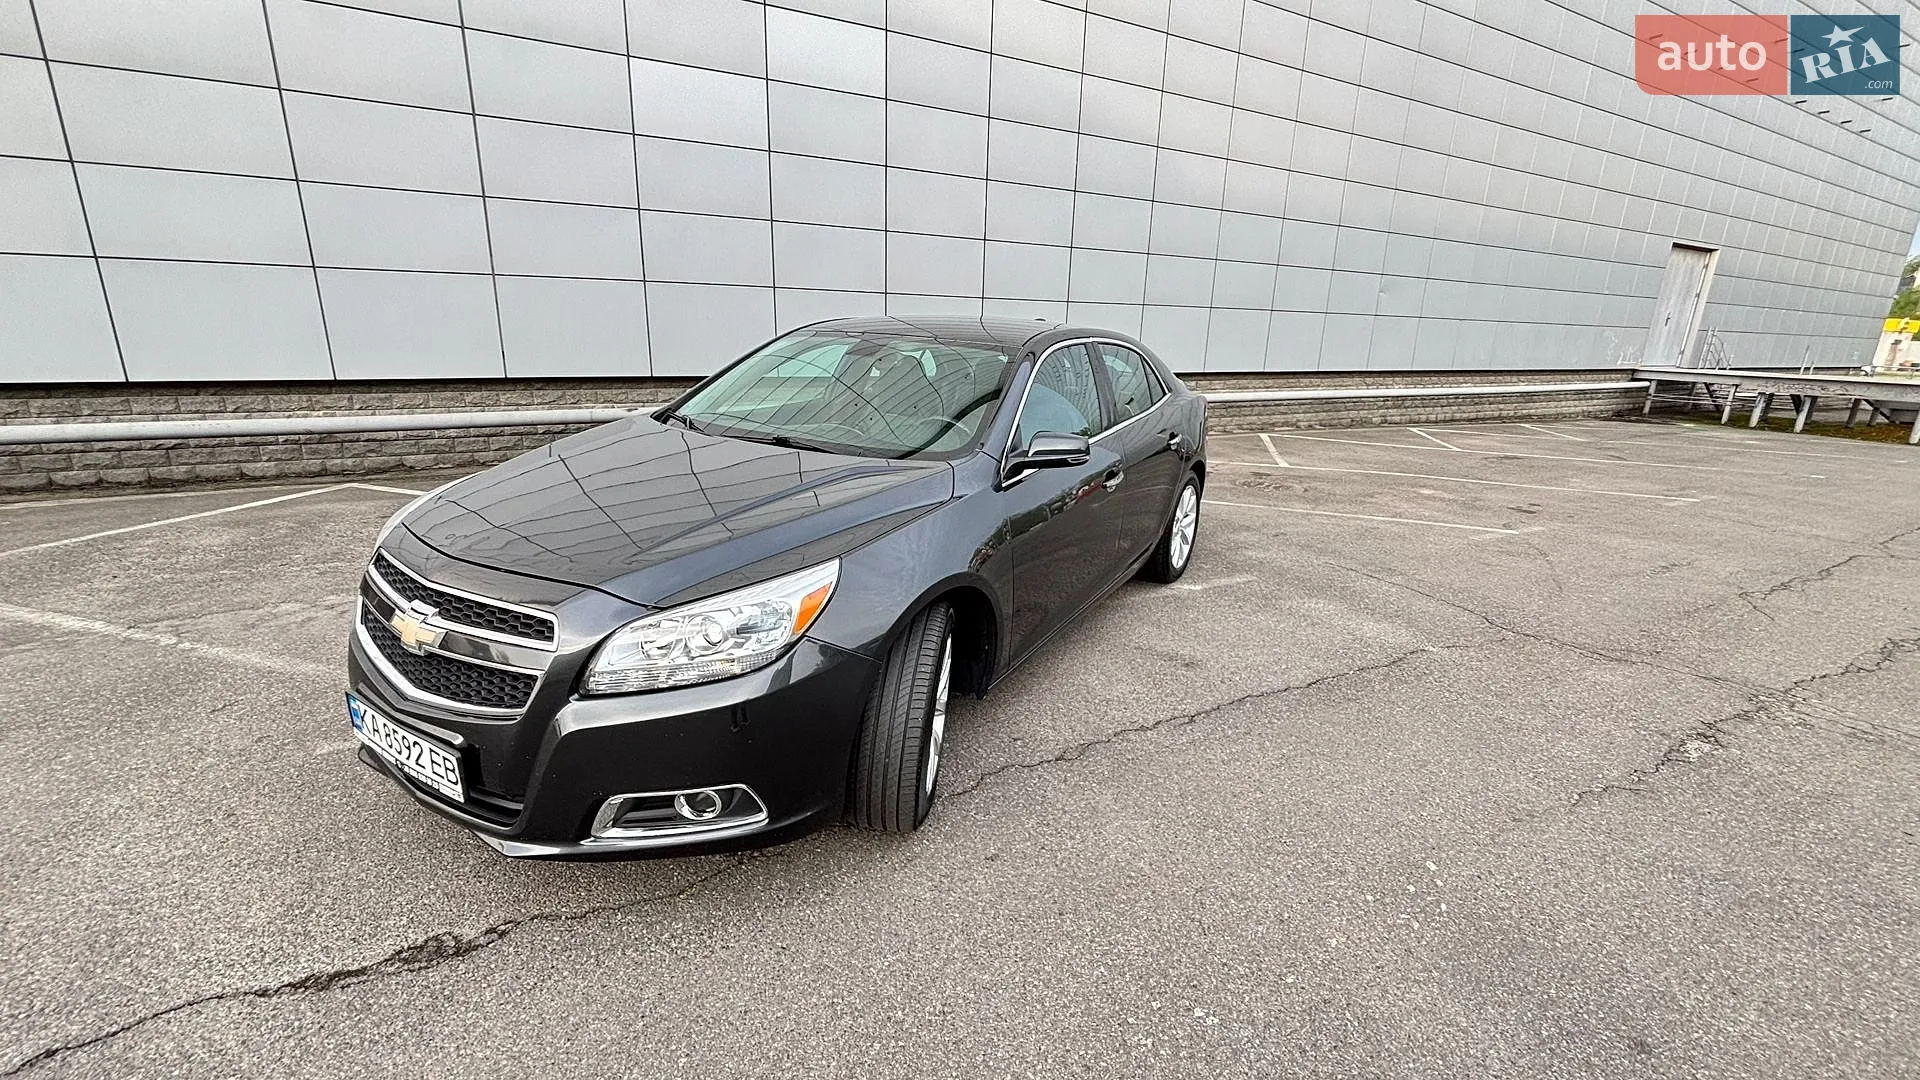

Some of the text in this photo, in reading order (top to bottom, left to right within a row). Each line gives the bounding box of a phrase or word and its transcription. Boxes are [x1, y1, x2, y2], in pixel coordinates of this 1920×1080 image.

[360, 709, 383, 743] KA
[383, 722, 427, 770] 8592
[429, 747, 459, 786] EB
